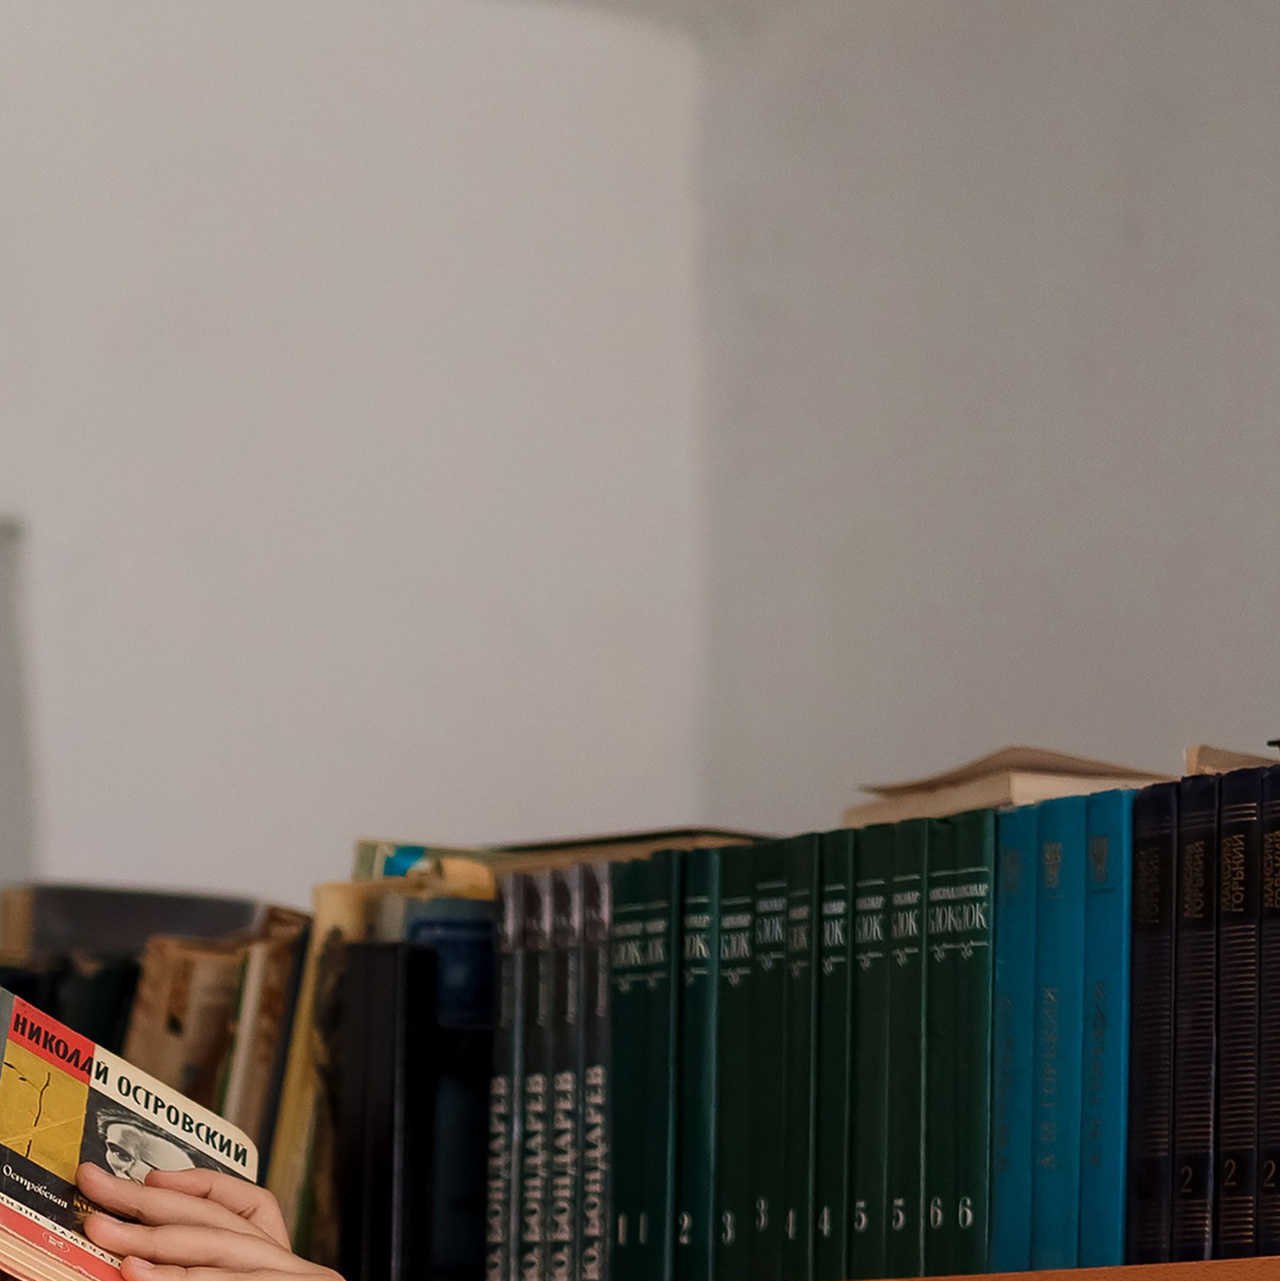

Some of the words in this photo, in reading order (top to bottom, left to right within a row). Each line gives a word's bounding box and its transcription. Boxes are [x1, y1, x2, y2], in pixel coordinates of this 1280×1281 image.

[1232, 833, 1246, 912] ГОРЬКИЙ
[13, 1013, 109, 1085] НИКОЛАЙ
[118, 1075, 248, 1168] ОСТРОВСКИЙ
[583, 1064, 610, 1236] БОНДАРЕВ
[1180, 1165, 1194, 1193] 2
[1223, 1158, 1238, 1187] 2
[1263, 1159, 1277, 1188] 2
[678, 1211, 693, 1246] 2
[722, 1210, 736, 1246] 3
[755, 1196, 769, 1232] 3
[854, 1199, 868, 1233] 5
[892, 1198, 906, 1232] 5
[929, 1196, 943, 1230] 6
[957, 1196, 973, 1231] 6
